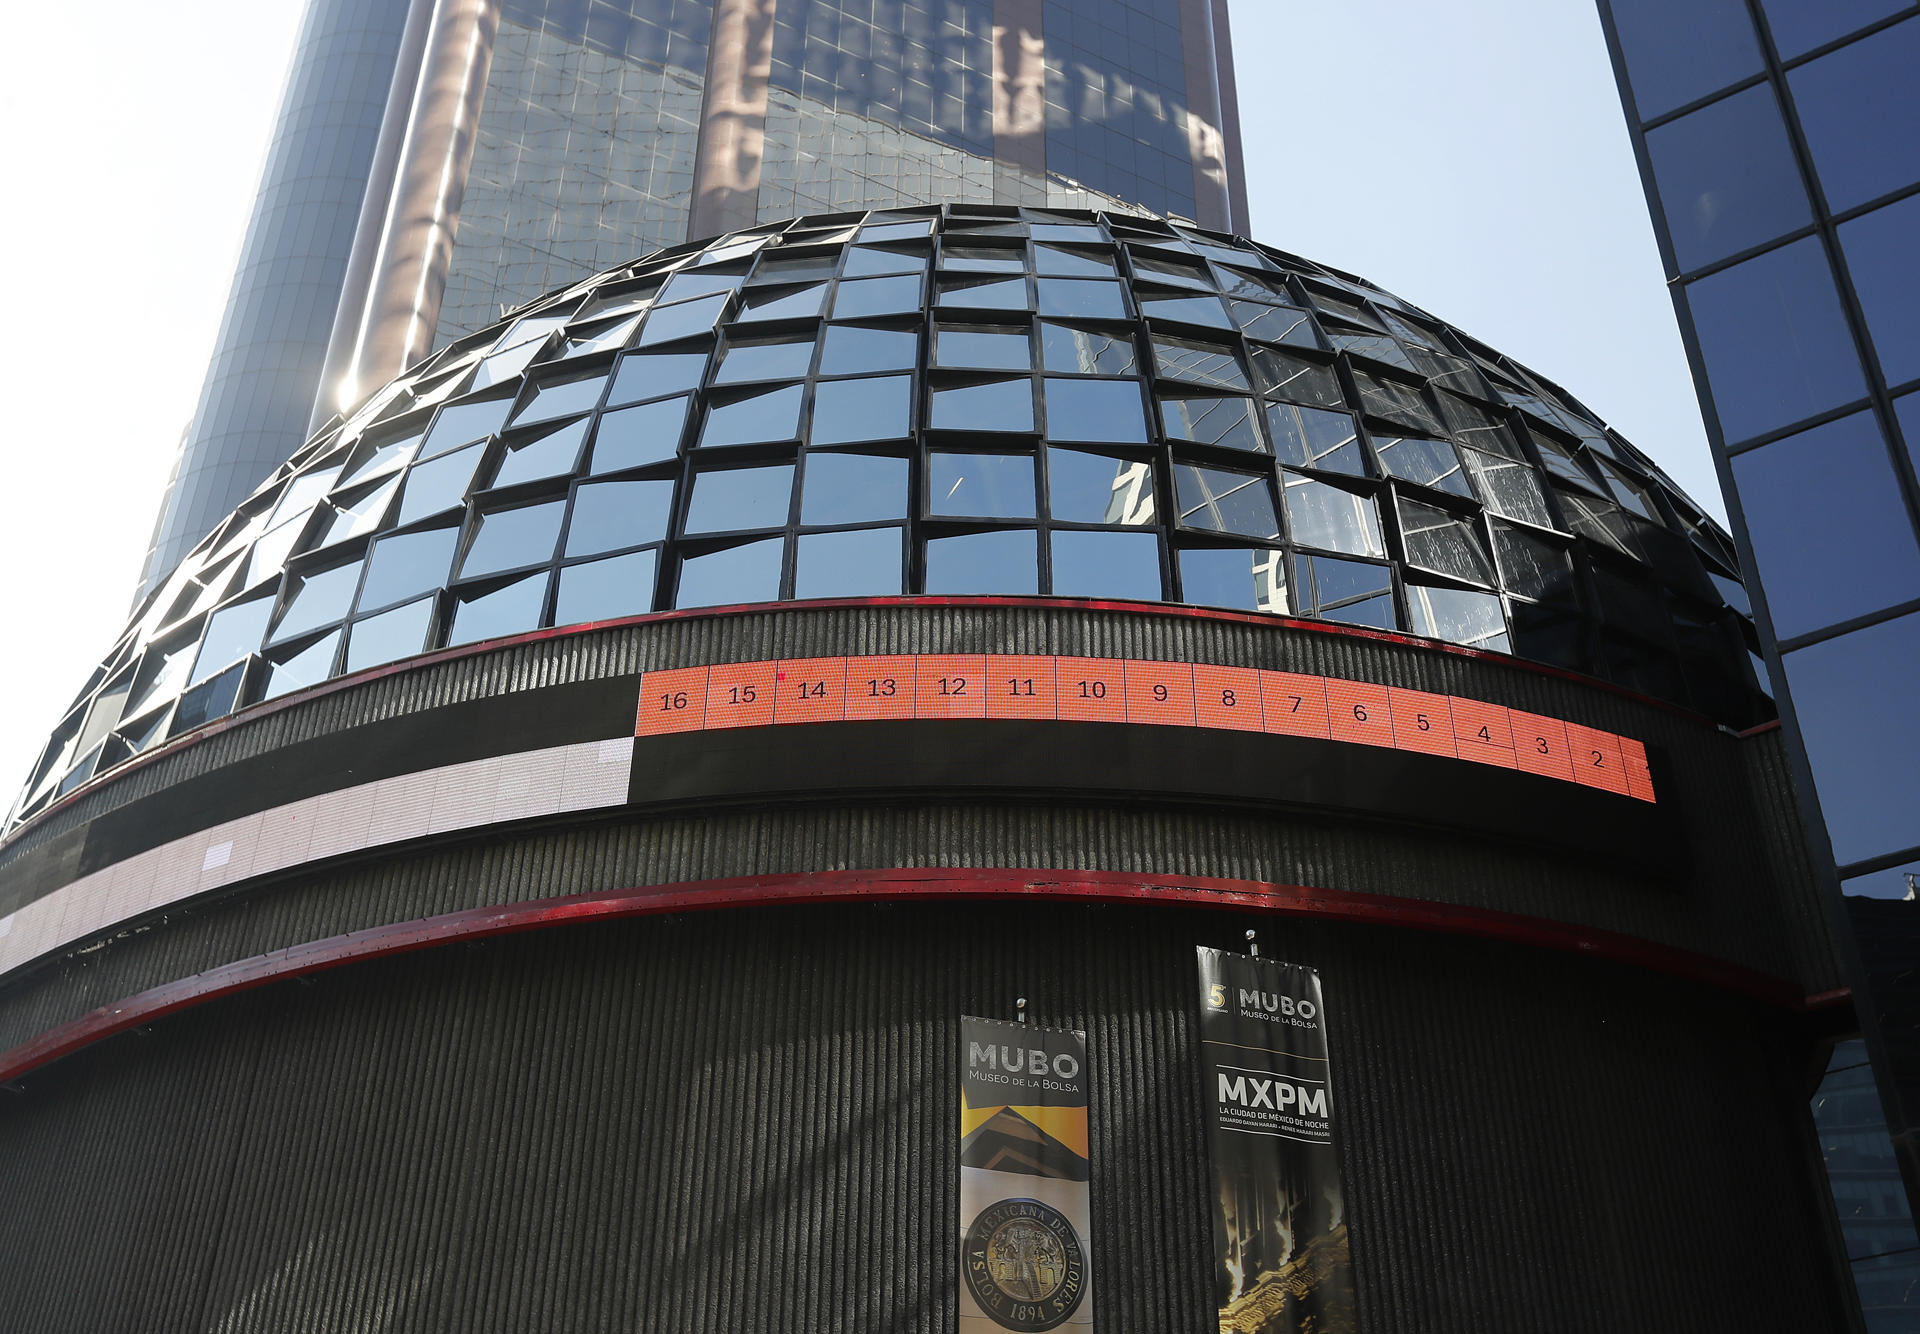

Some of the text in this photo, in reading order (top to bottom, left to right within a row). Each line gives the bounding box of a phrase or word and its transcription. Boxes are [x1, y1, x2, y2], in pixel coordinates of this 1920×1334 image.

[659, 677, 1605, 769] 16 15 14 13 12 11 10 9 8 7 6 5 4 3 2
[1239, 988, 1316, 1019] MUBO
[1241, 1009, 1318, 1029] MUSEO DE LA BOLSA
[969, 1041, 1079, 1079] MUBO
[969, 1070, 1079, 1092] MUSEO DE LA BOLSA
[1218, 1073, 1328, 1118] MXPM
[1219, 1106, 1329, 1129] LA CIUDAD DE MÉXICO DE NOCHE
[1219, 1116, 1242, 1125] EDUARDO
[972, 1204, 1081, 1313] BOLSA MEXICANA DE VALORES
[1010, 1303, 1046, 1321] 1894
